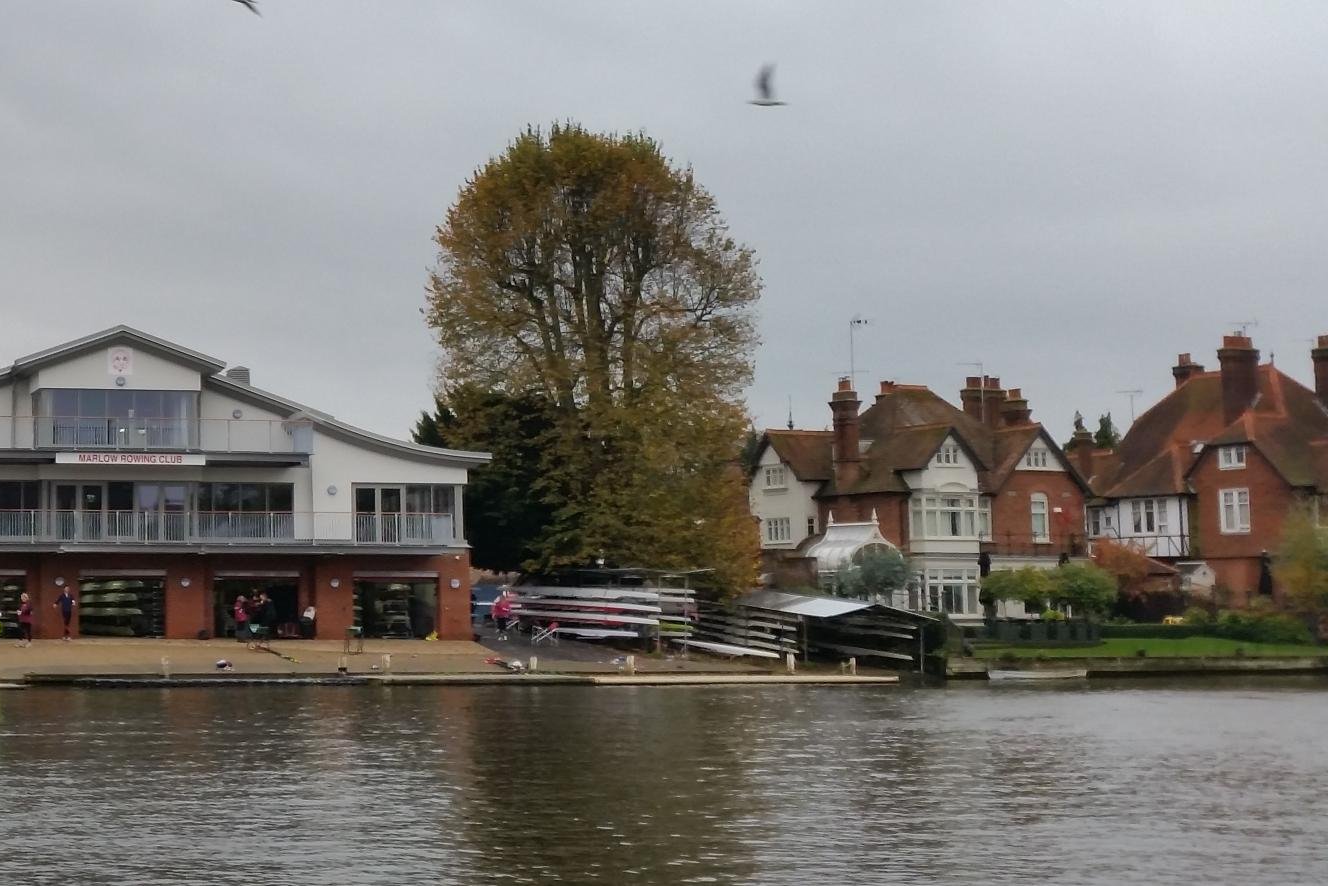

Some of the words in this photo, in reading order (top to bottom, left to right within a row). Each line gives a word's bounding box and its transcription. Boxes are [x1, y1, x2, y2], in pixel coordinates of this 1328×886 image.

[78, 454, 118, 463] MARLOW
[120, 454, 156, 464] ROWING
[158, 455, 183, 464] CLUB
